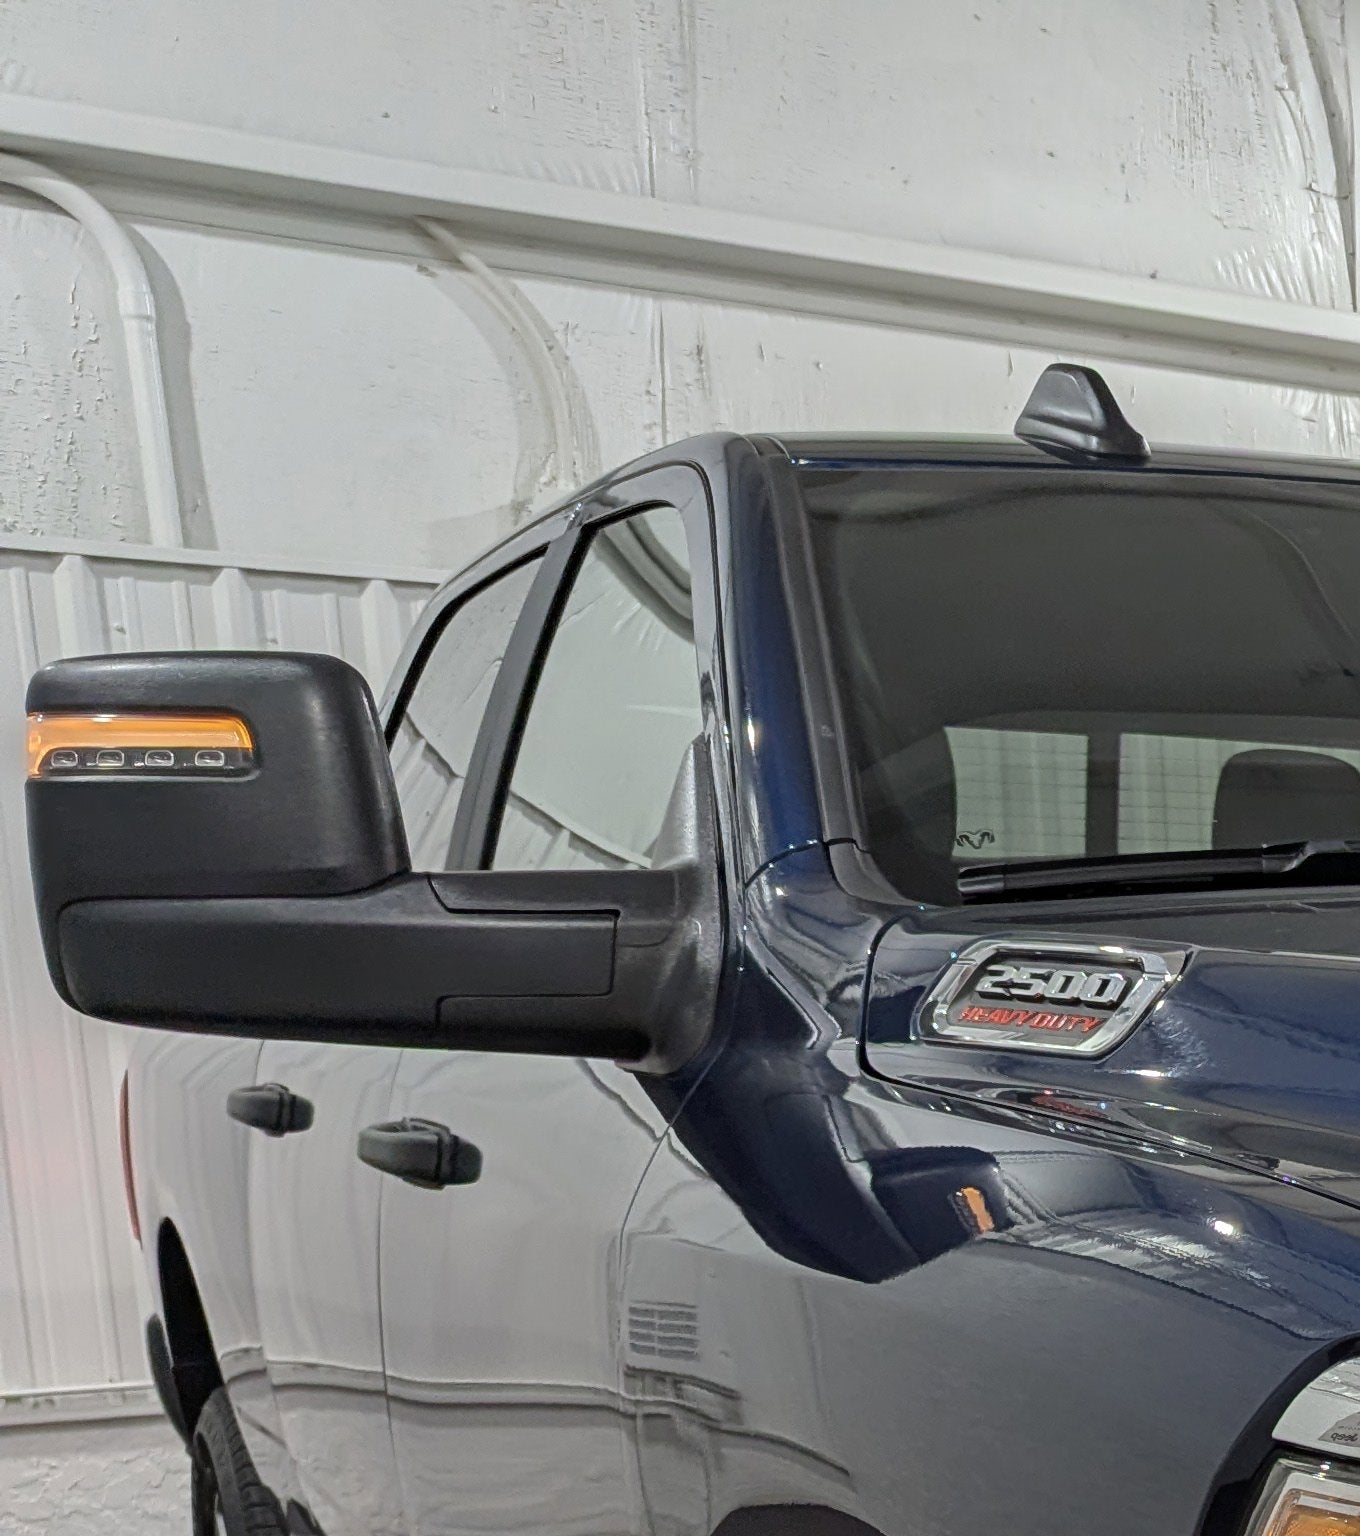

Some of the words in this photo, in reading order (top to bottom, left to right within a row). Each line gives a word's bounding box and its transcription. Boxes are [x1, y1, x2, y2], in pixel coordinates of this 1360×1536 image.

[975, 965, 1127, 1008] 2500
[958, 1004, 1032, 1026] HEAVY
[1030, 1010, 1103, 1034] DUTY
